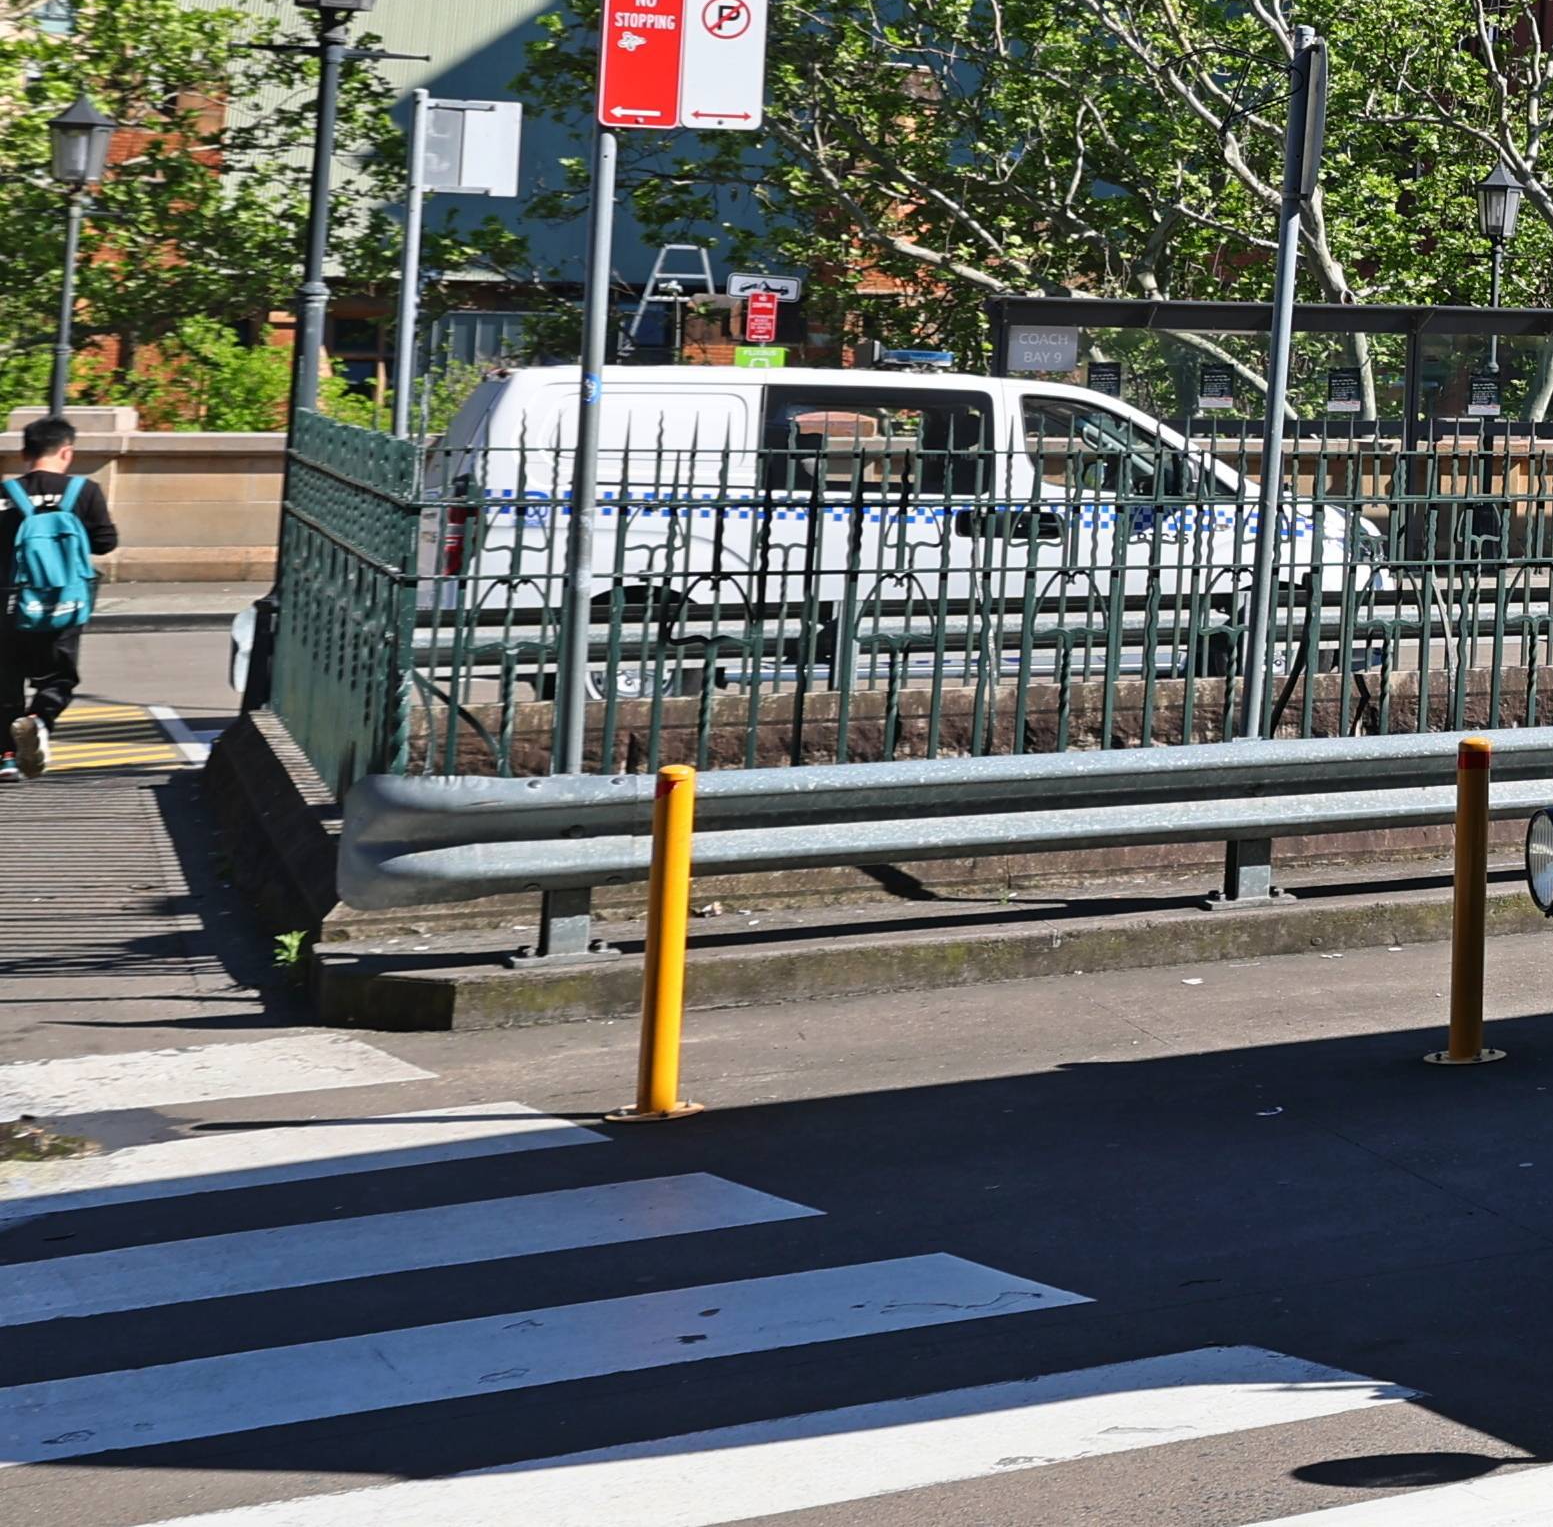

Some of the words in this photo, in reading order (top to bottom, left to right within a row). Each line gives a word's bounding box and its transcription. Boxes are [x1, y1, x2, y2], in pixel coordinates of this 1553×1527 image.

[614, 11, 676, 30] STOPPING
[1019, 333, 1068, 345] COACH
[1023, 352, 1050, 363] BAY
[1054, 353, 1062, 363] 9
